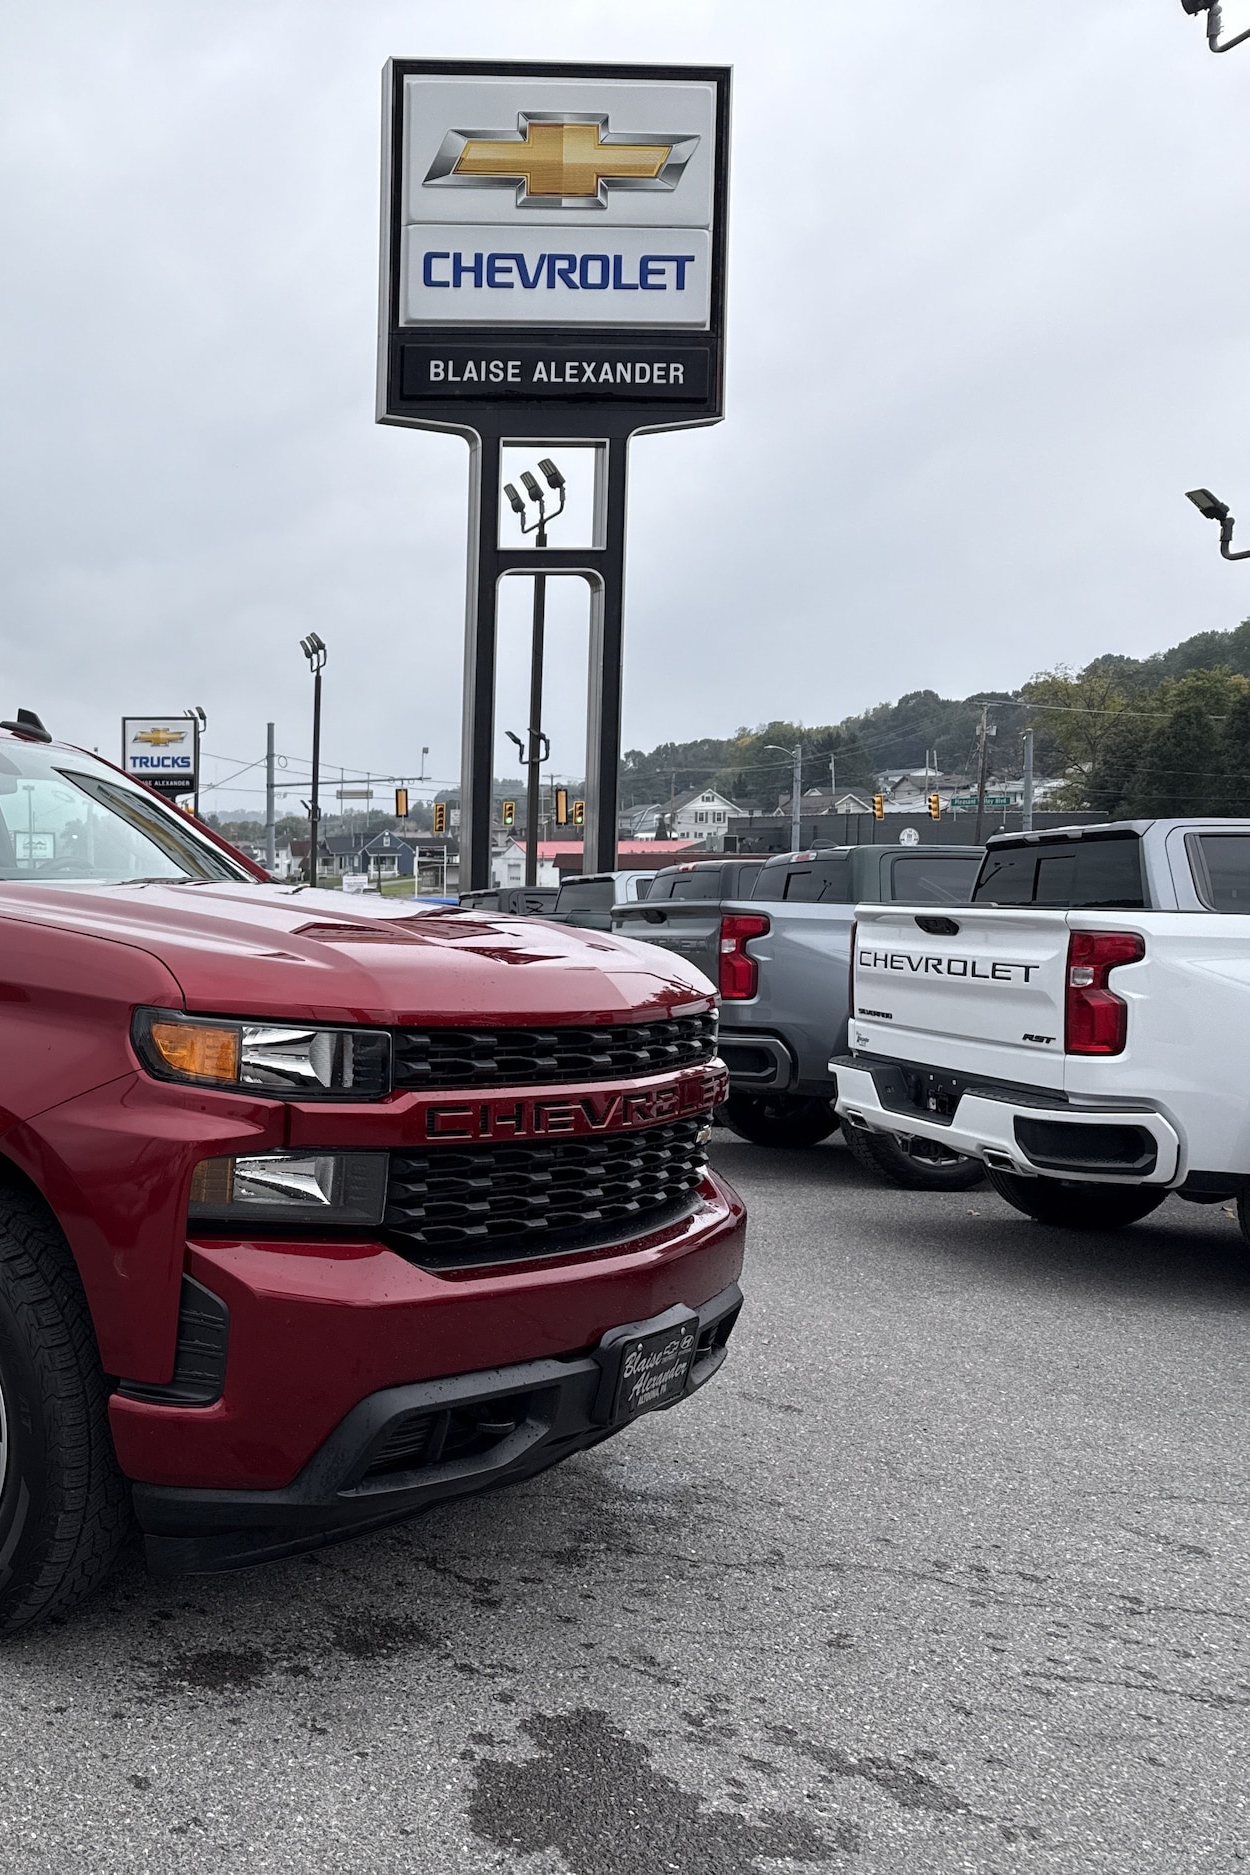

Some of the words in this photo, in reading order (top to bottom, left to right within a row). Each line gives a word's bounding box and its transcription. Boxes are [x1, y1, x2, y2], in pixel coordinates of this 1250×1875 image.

[423, 251, 695, 291] CHEVROLET
[429, 360, 522, 384] BLAISE
[532, 361, 685, 385] ALEXANDER
[130, 756, 191, 768] TRUCKS
[859, 951, 1040, 983] CHEVROLET
[1022, 1033, 1056, 1044] RST
[425, 1074, 728, 1139] CHEVROLET
[623, 1351, 663, 1379] Blaise
[628, 1357, 688, 1402] Alexander
